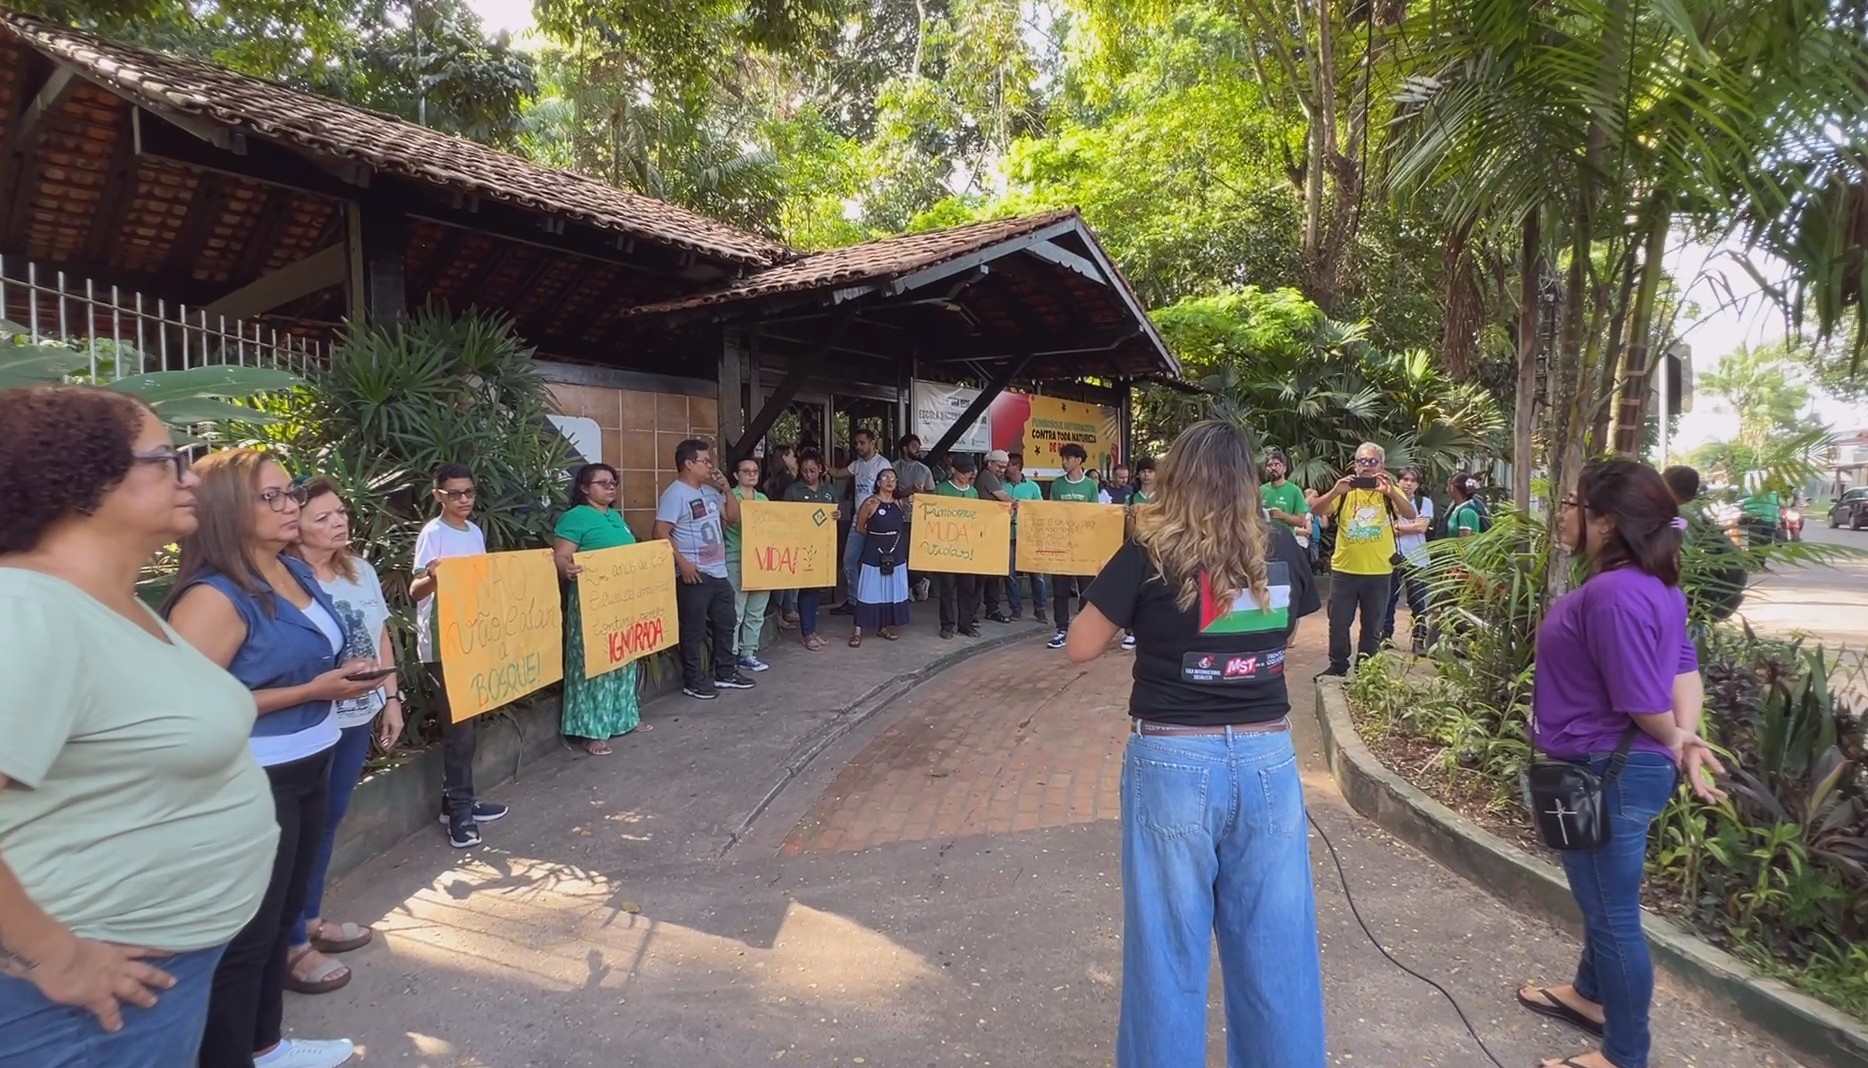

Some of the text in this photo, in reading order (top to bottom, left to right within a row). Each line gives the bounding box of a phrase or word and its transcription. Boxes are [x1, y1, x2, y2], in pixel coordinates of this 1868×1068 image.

[1031, 429, 1097, 444] CONTRA TODA NATUREZA
[924, 520, 969, 544] MUDA
[919, 541, 975, 561] Vidas!
[612, 562, 637, 578] anos
[637, 555, 649, 570] de
[607, 617, 665, 665] IGNORADA
[1227, 656, 1257, 675] MST
[470, 651, 541, 708] BOSQUE!
